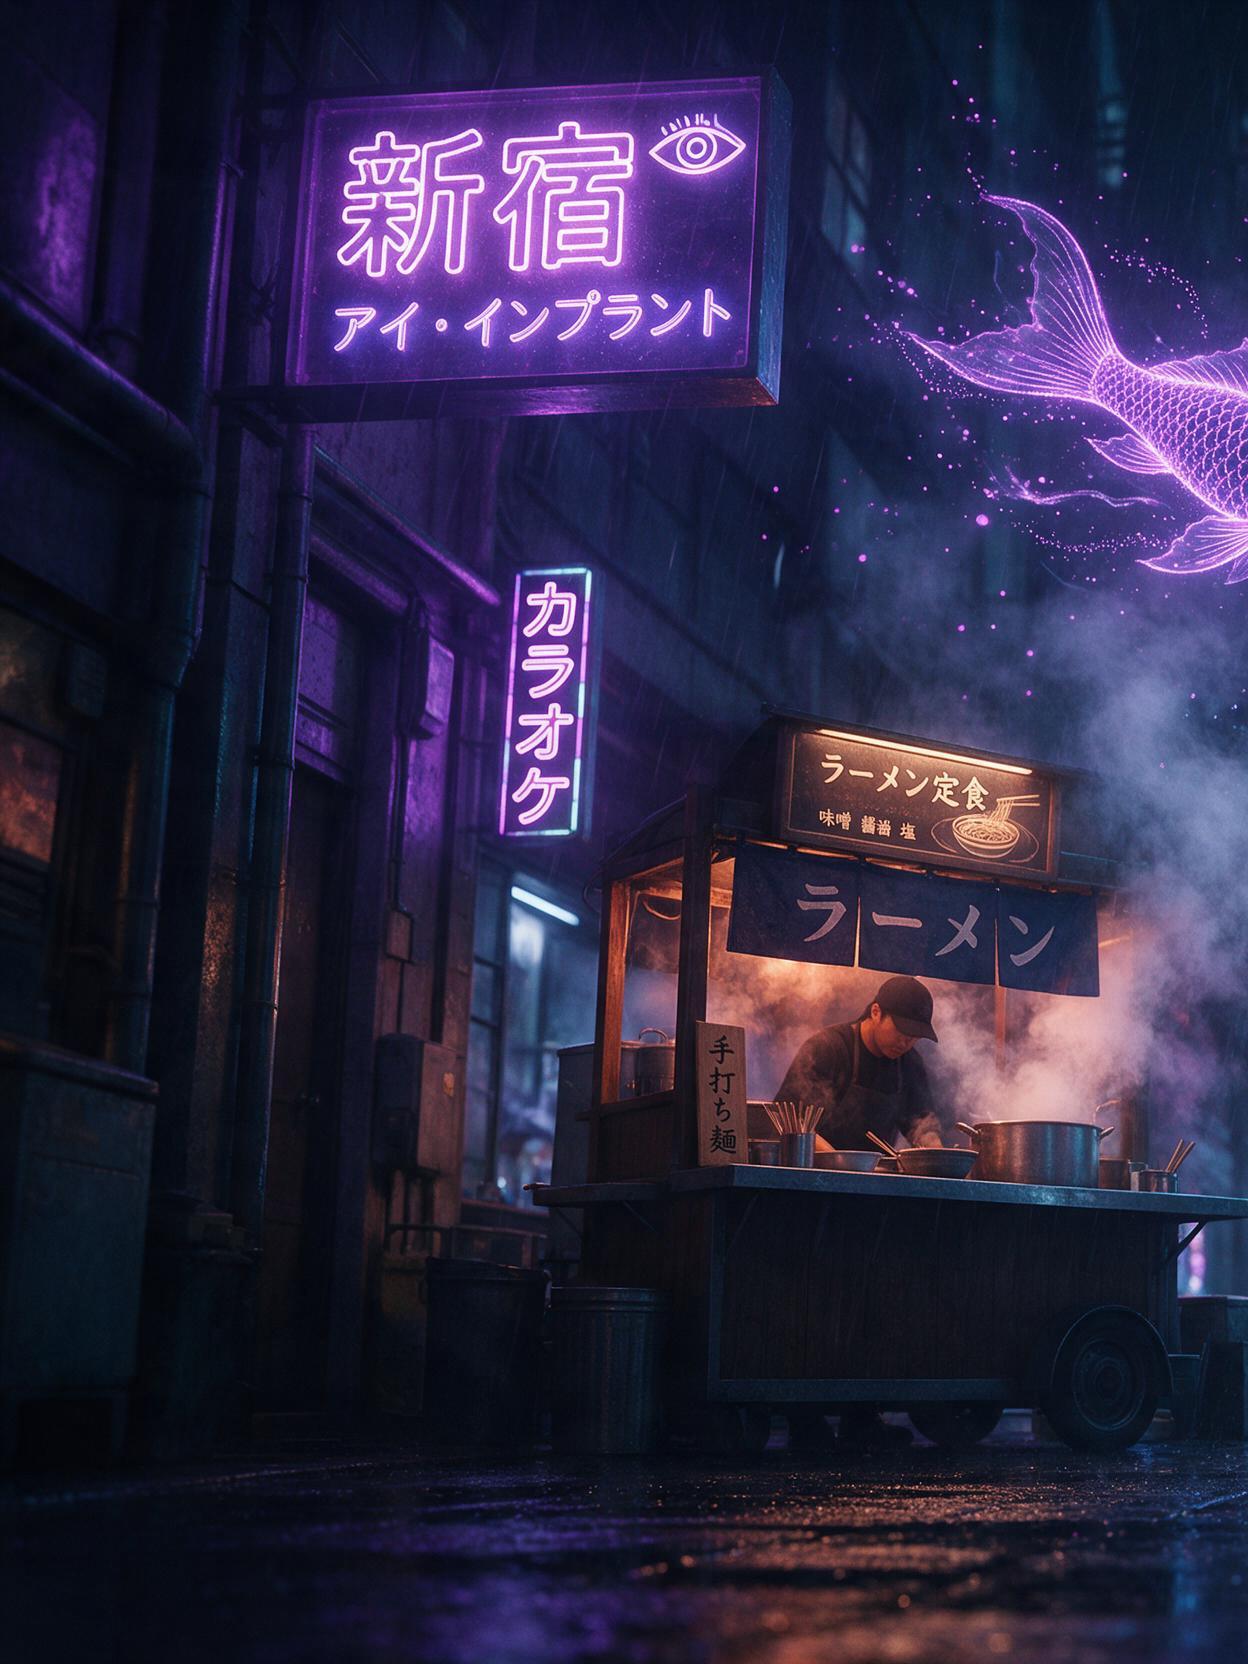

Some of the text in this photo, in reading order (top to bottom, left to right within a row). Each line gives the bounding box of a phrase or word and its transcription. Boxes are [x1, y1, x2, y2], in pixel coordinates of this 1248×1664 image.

[337, 121, 634, 277] 新宿
[334, 288, 732, 352] アイ・インプラント
[511, 581, 577, 826] カラオケ
[821, 753, 990, 812] ラーメン定食
[797, 883, 1055, 967] ラーメン
[708, 1034, 737, 1154] 手打ち麺
